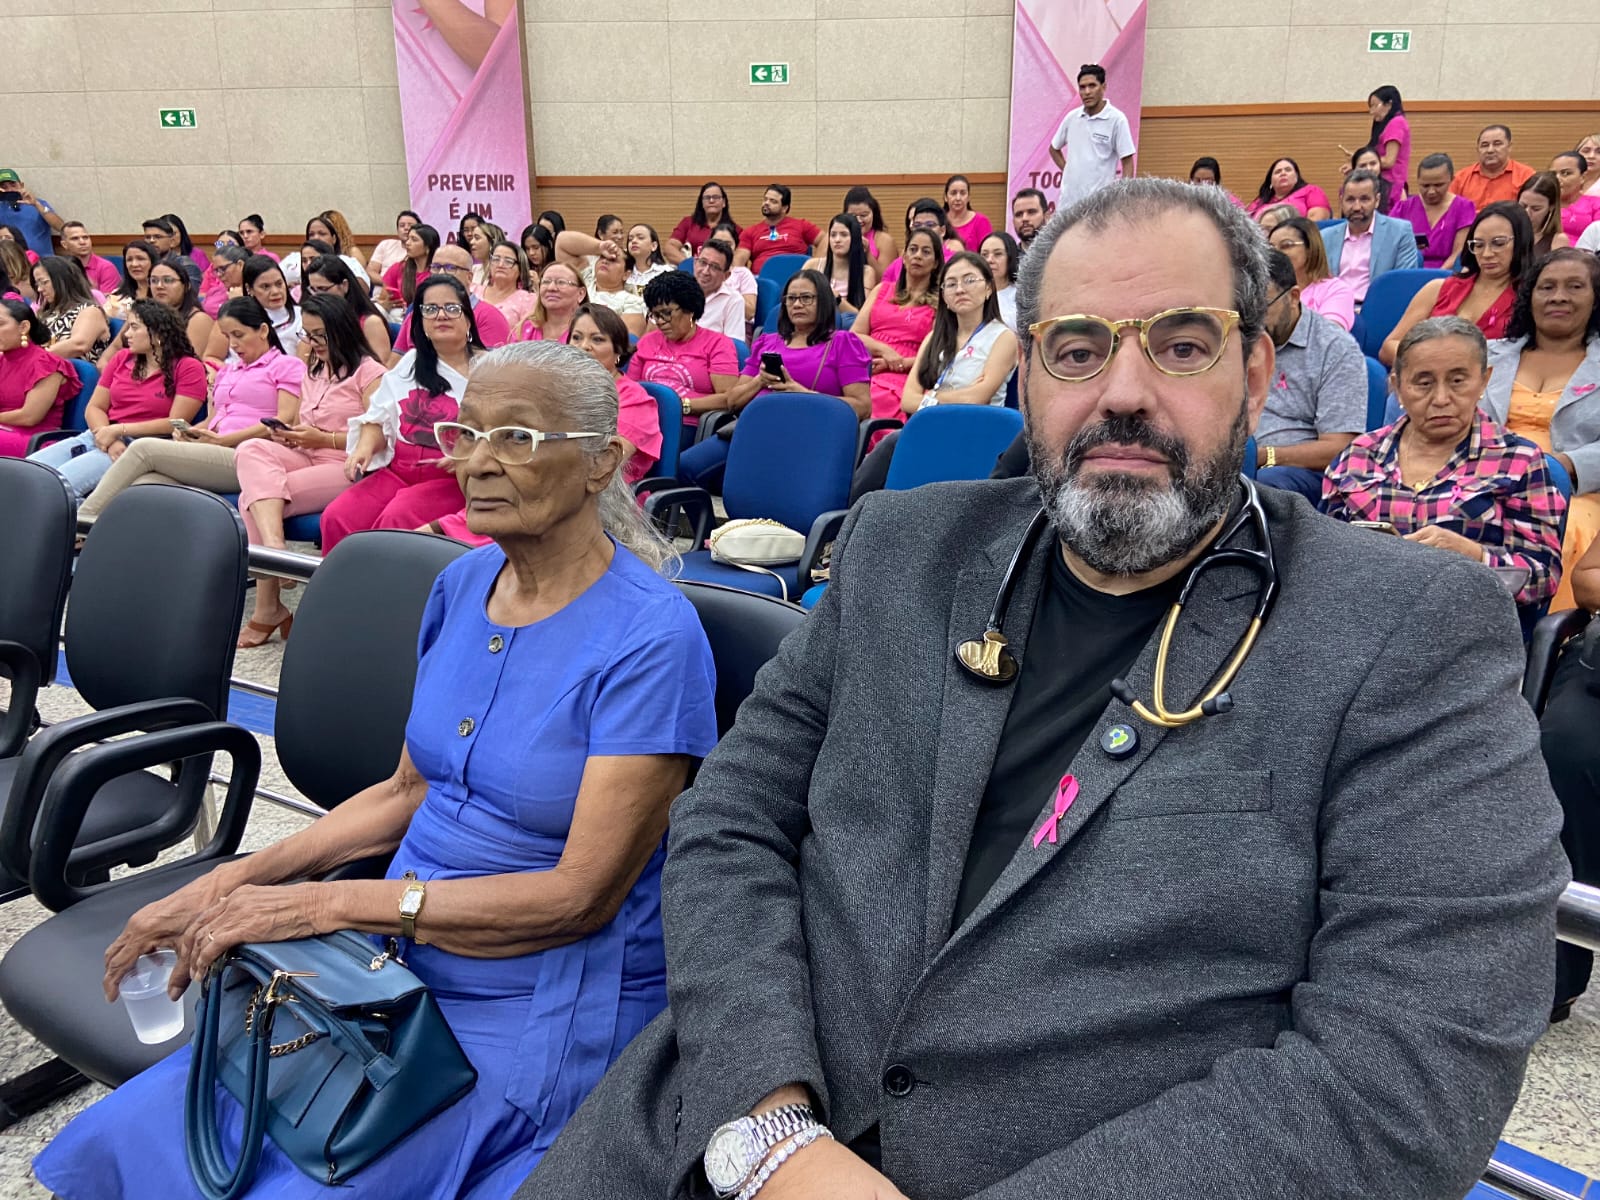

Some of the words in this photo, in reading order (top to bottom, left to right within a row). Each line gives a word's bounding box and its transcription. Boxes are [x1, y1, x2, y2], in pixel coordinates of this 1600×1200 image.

[427, 174, 515, 192] PREVENIR
[449, 197, 460, 219] É
[467, 203, 493, 220] UM
